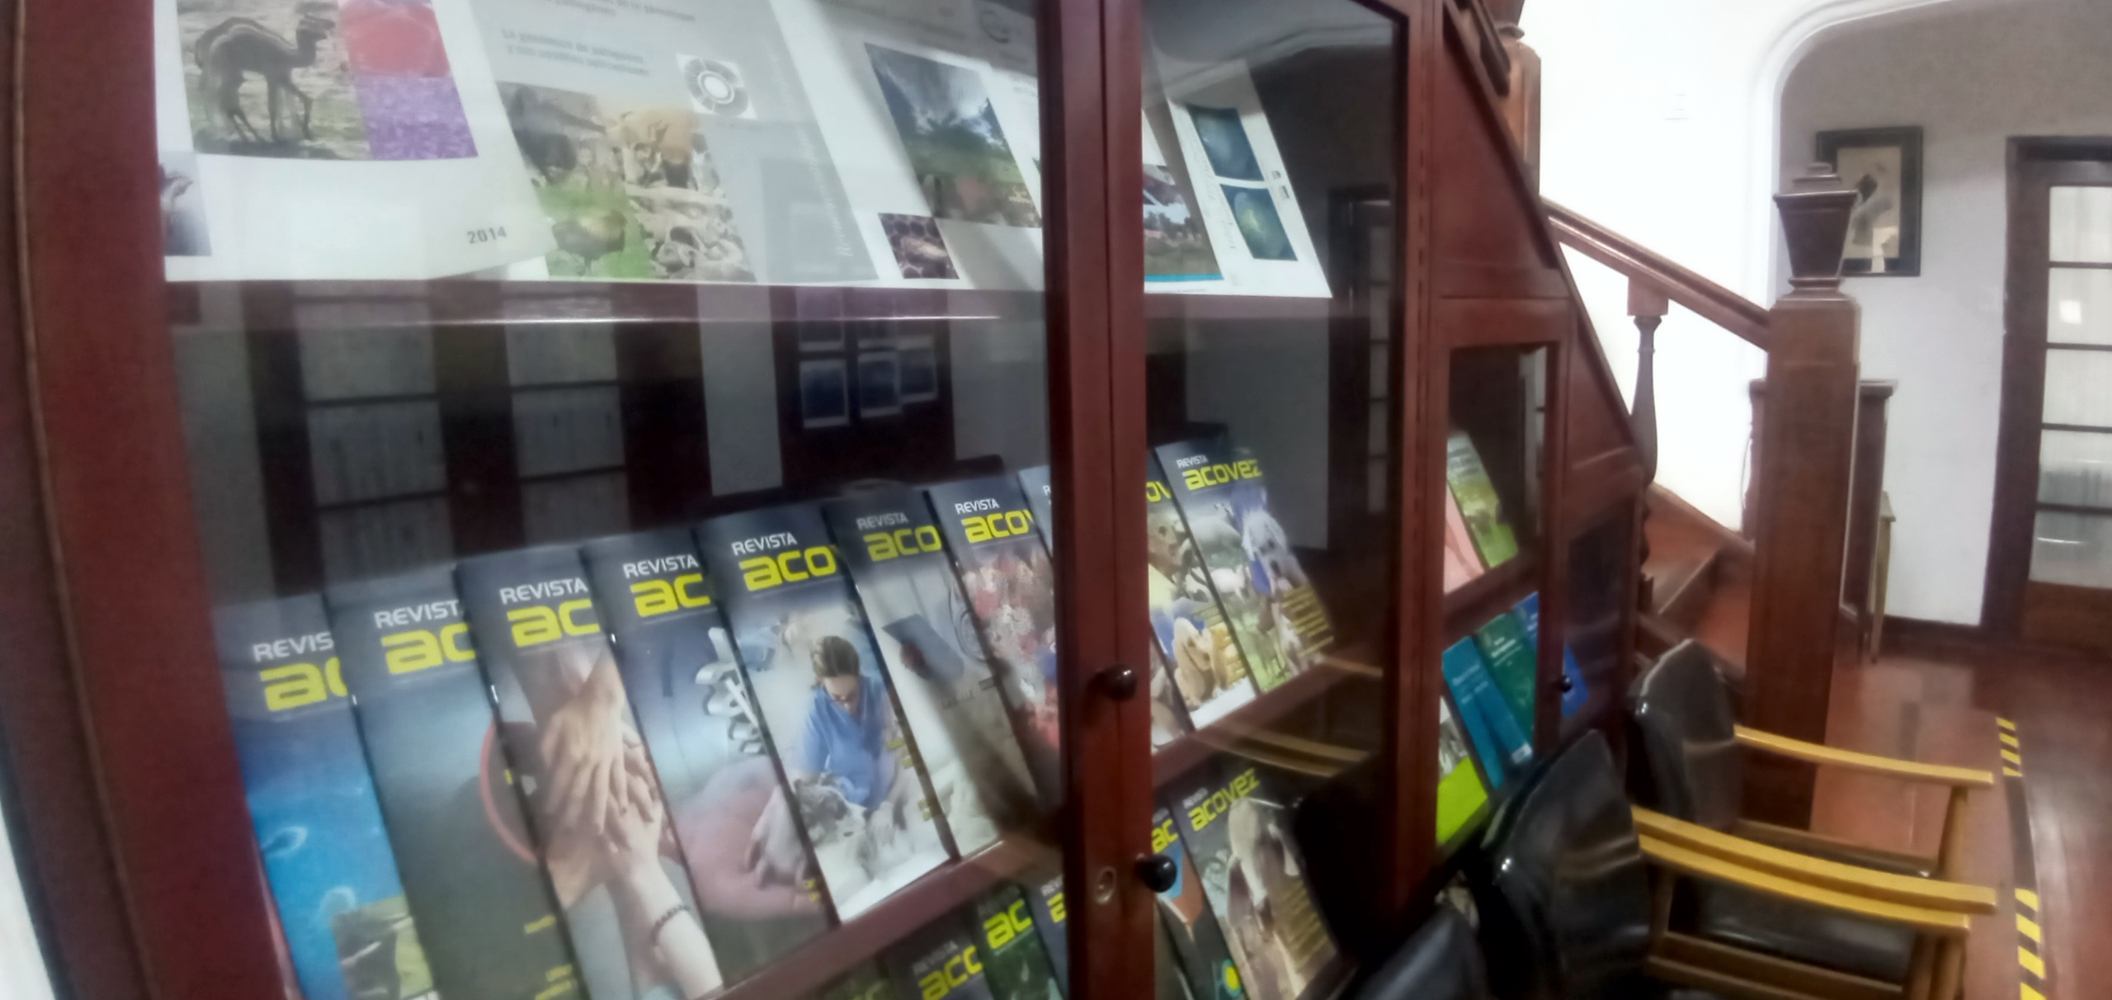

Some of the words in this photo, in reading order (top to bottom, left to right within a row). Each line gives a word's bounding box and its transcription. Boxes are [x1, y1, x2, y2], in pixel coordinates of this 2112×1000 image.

[466, 226, 507, 245] 2014
[1175, 454, 1209, 469] REVISTA
[1182, 458, 1262, 491] acovez
[856, 512, 908, 531] REVISTA
[954, 498, 1000, 515] REVISTA
[731, 532, 798, 556] REVISTA
[863, 525, 942, 562] aco
[622, 554, 699, 579] REVISTA
[499, 577, 588, 605] REVISTA
[630, 573, 711, 618] ac
[506, 598, 600, 648] ac
[252, 631, 334, 663] REVIS
[380, 622, 476, 675] ac
[1188, 767, 1260, 831] acovez
[984, 899, 1032, 949] ac
